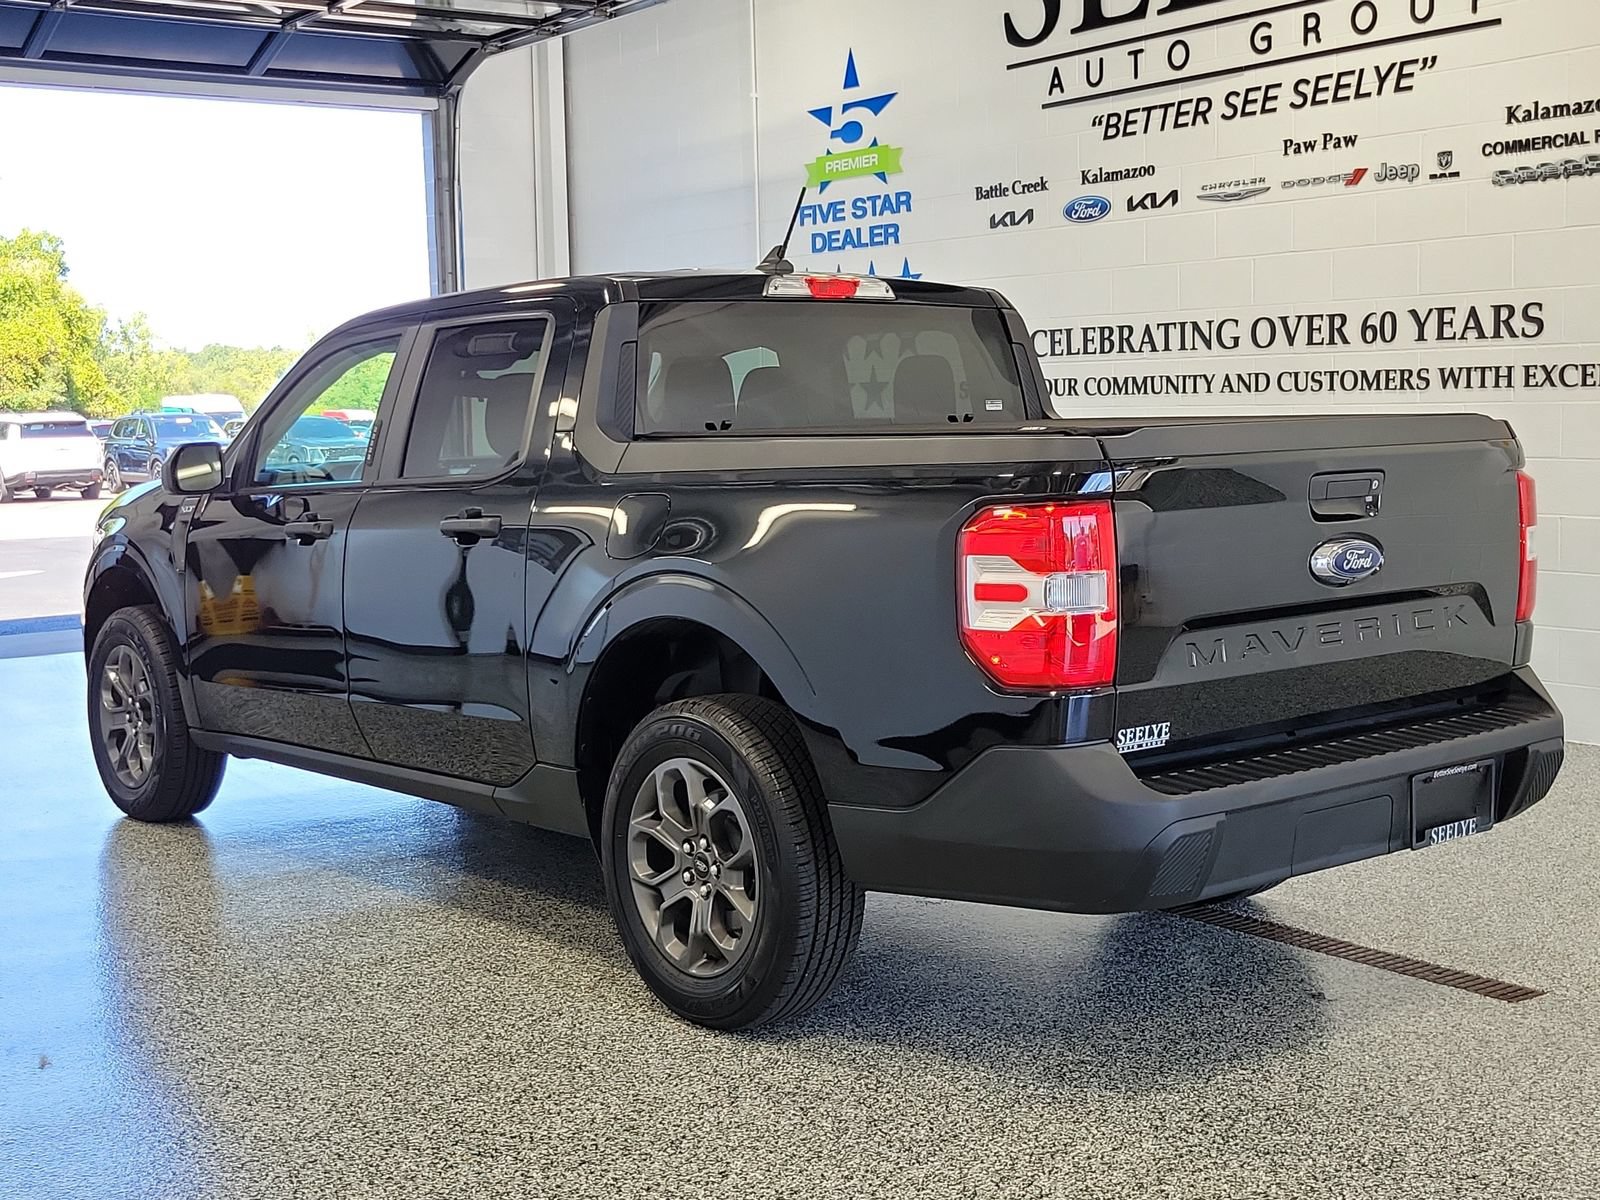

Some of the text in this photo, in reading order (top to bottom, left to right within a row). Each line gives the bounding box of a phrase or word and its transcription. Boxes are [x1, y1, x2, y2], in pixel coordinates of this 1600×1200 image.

[1049, 40, 1190, 96] AUTO
[1091, 55, 1438, 141] “BETTER SEE SEELYE”
[1283, 133, 1358, 156] Paw Paw
[1482, 131, 1590, 157] COMMERCIAL
[825, 153, 878, 174] PREMIER
[1080, 164, 1155, 185] Kalamazoo
[1374, 163, 1420, 183] Jeep
[975, 176, 1049, 201] Battle Creek
[1281, 172, 1354, 188] DODGE
[800, 191, 912, 227] FIVE STAR
[1071, 199, 1102, 219] Ford
[1127, 189, 1179, 212] KIA
[990, 208, 1034, 229] KIA
[811, 223, 900, 253] DEALER
[1030, 302, 1545, 357] CELEBRATING OVER 60 YEARS
[1084, 374, 1215, 396] COMMUNITY
[1220, 372, 1271, 393] AND
[1277, 368, 1431, 393] CUSTOMERS
[1437, 365, 1516, 389] WITH
[1343, 549, 1373, 570] Ford
[1185, 604, 1469, 668] MAVERICK
[1117, 722, 1170, 746] SEELYE
[1430, 818, 1477, 845] SEELYE
